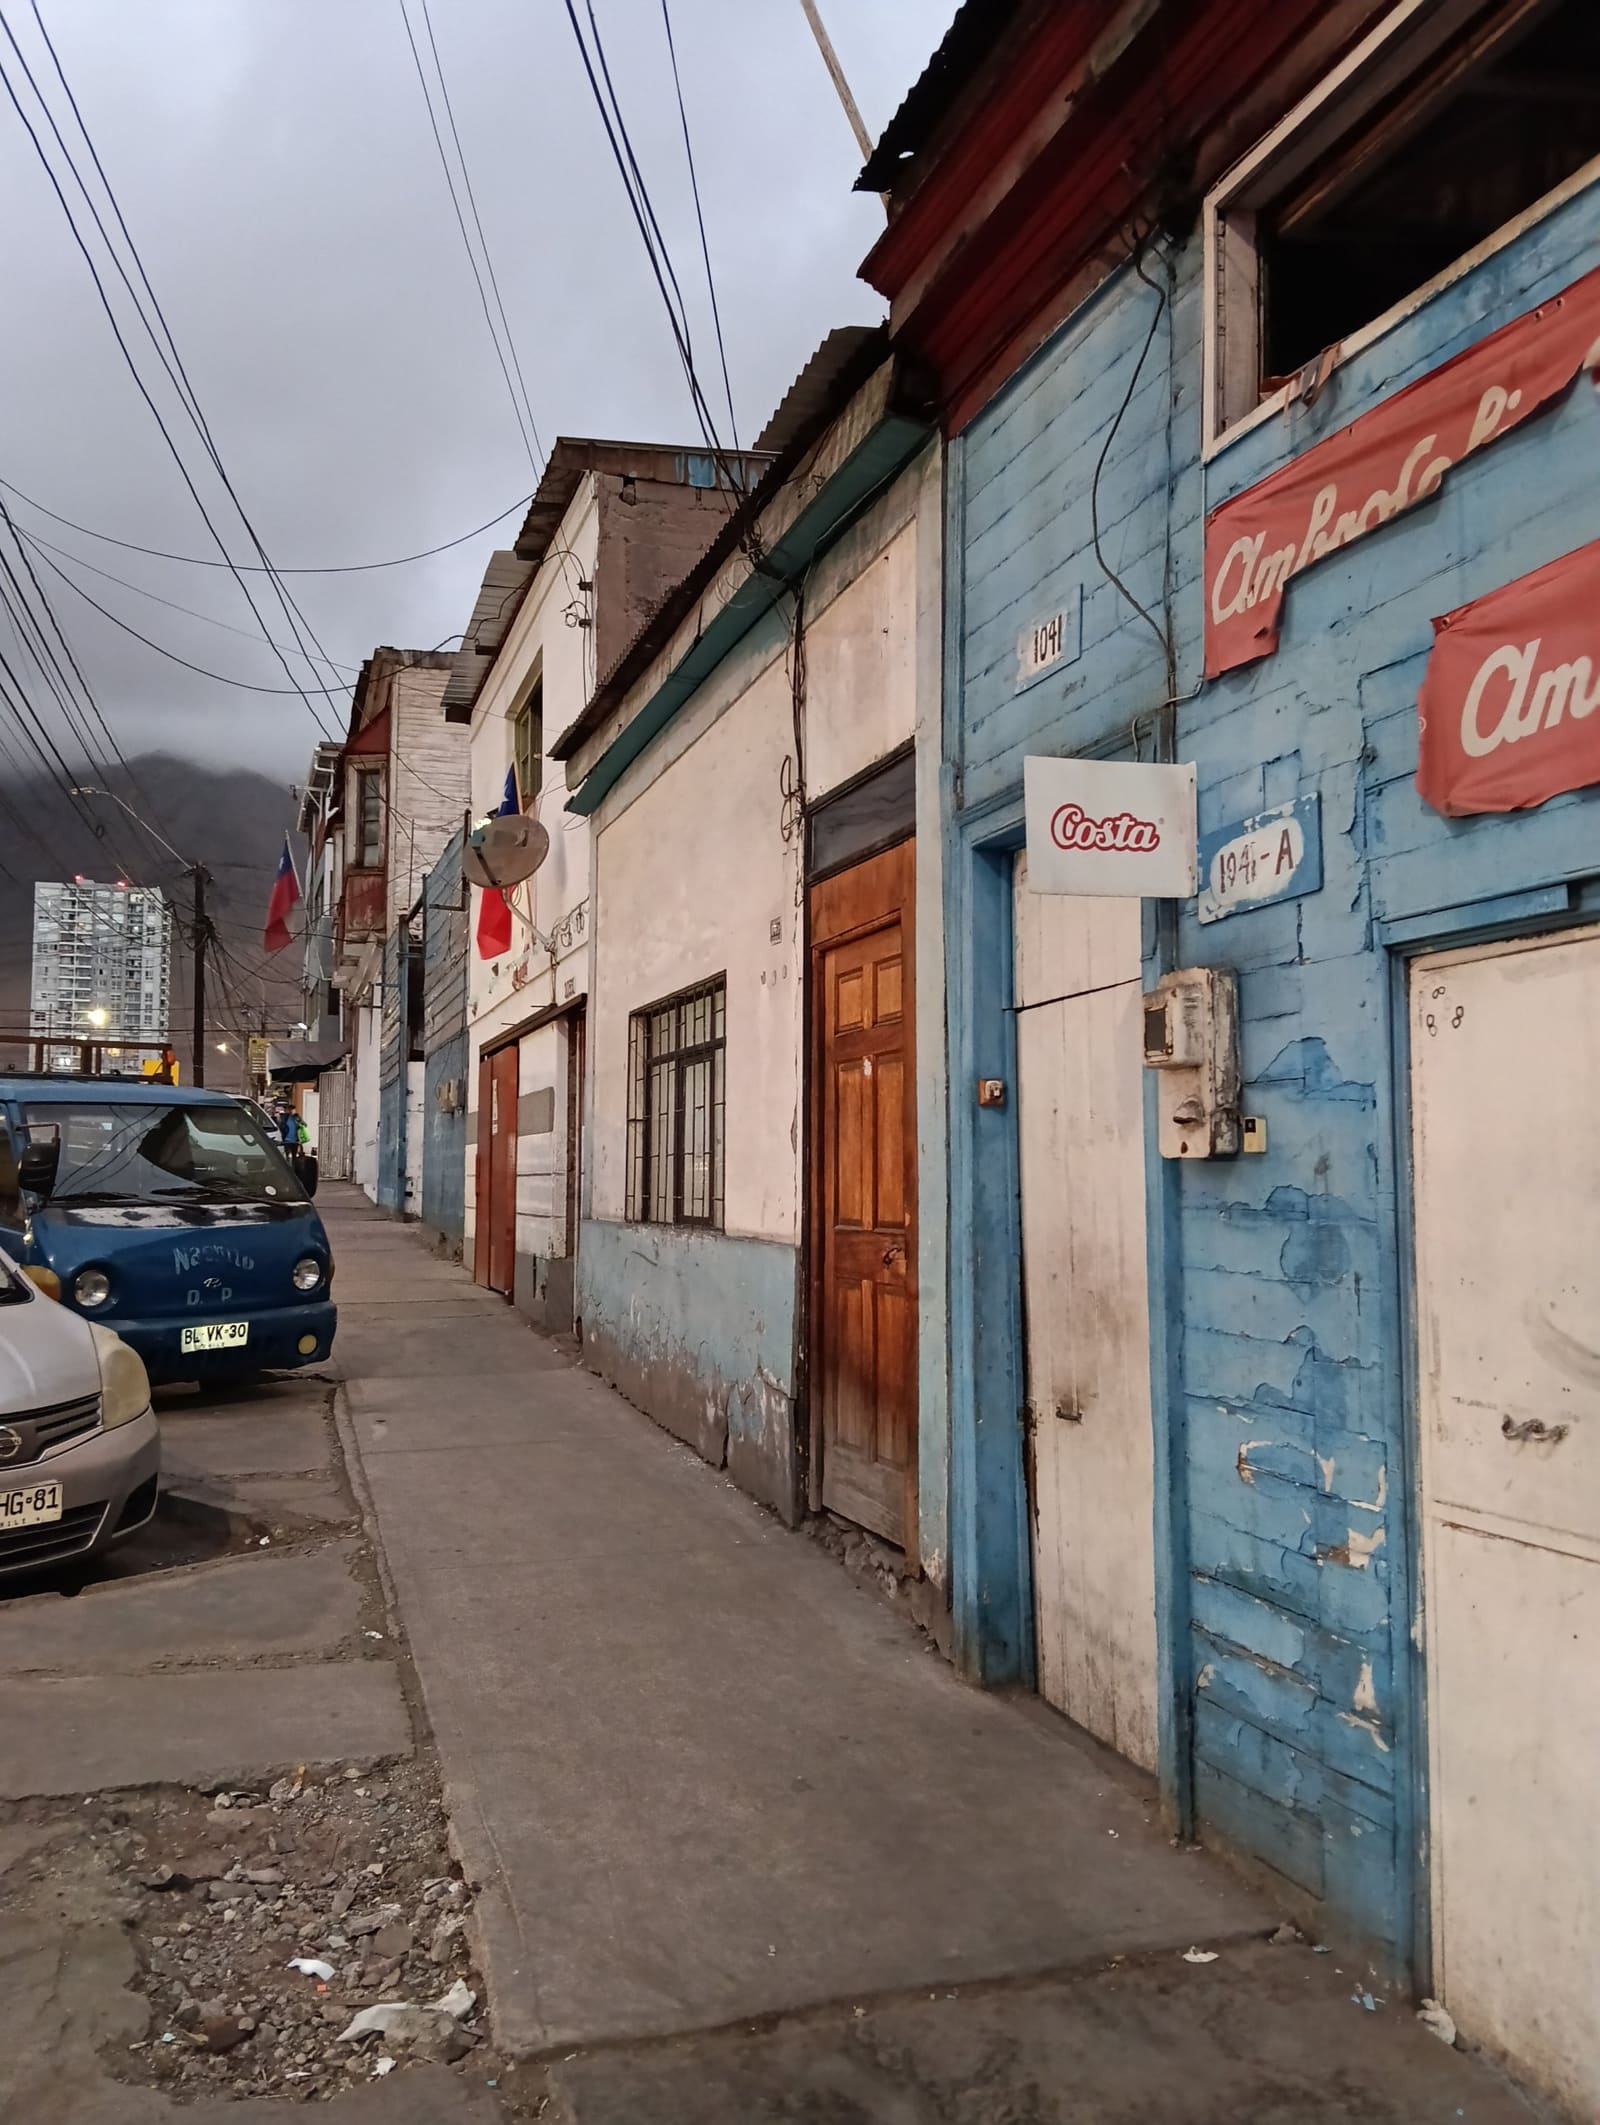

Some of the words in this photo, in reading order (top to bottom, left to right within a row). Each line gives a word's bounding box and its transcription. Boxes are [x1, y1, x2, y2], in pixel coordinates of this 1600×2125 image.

[1212, 386, 1521, 625] Ambrosol
[1034, 614, 1062, 663] 1041
[1461, 638, 1600, 757] Am
[1051, 803, 1160, 852] Costa
